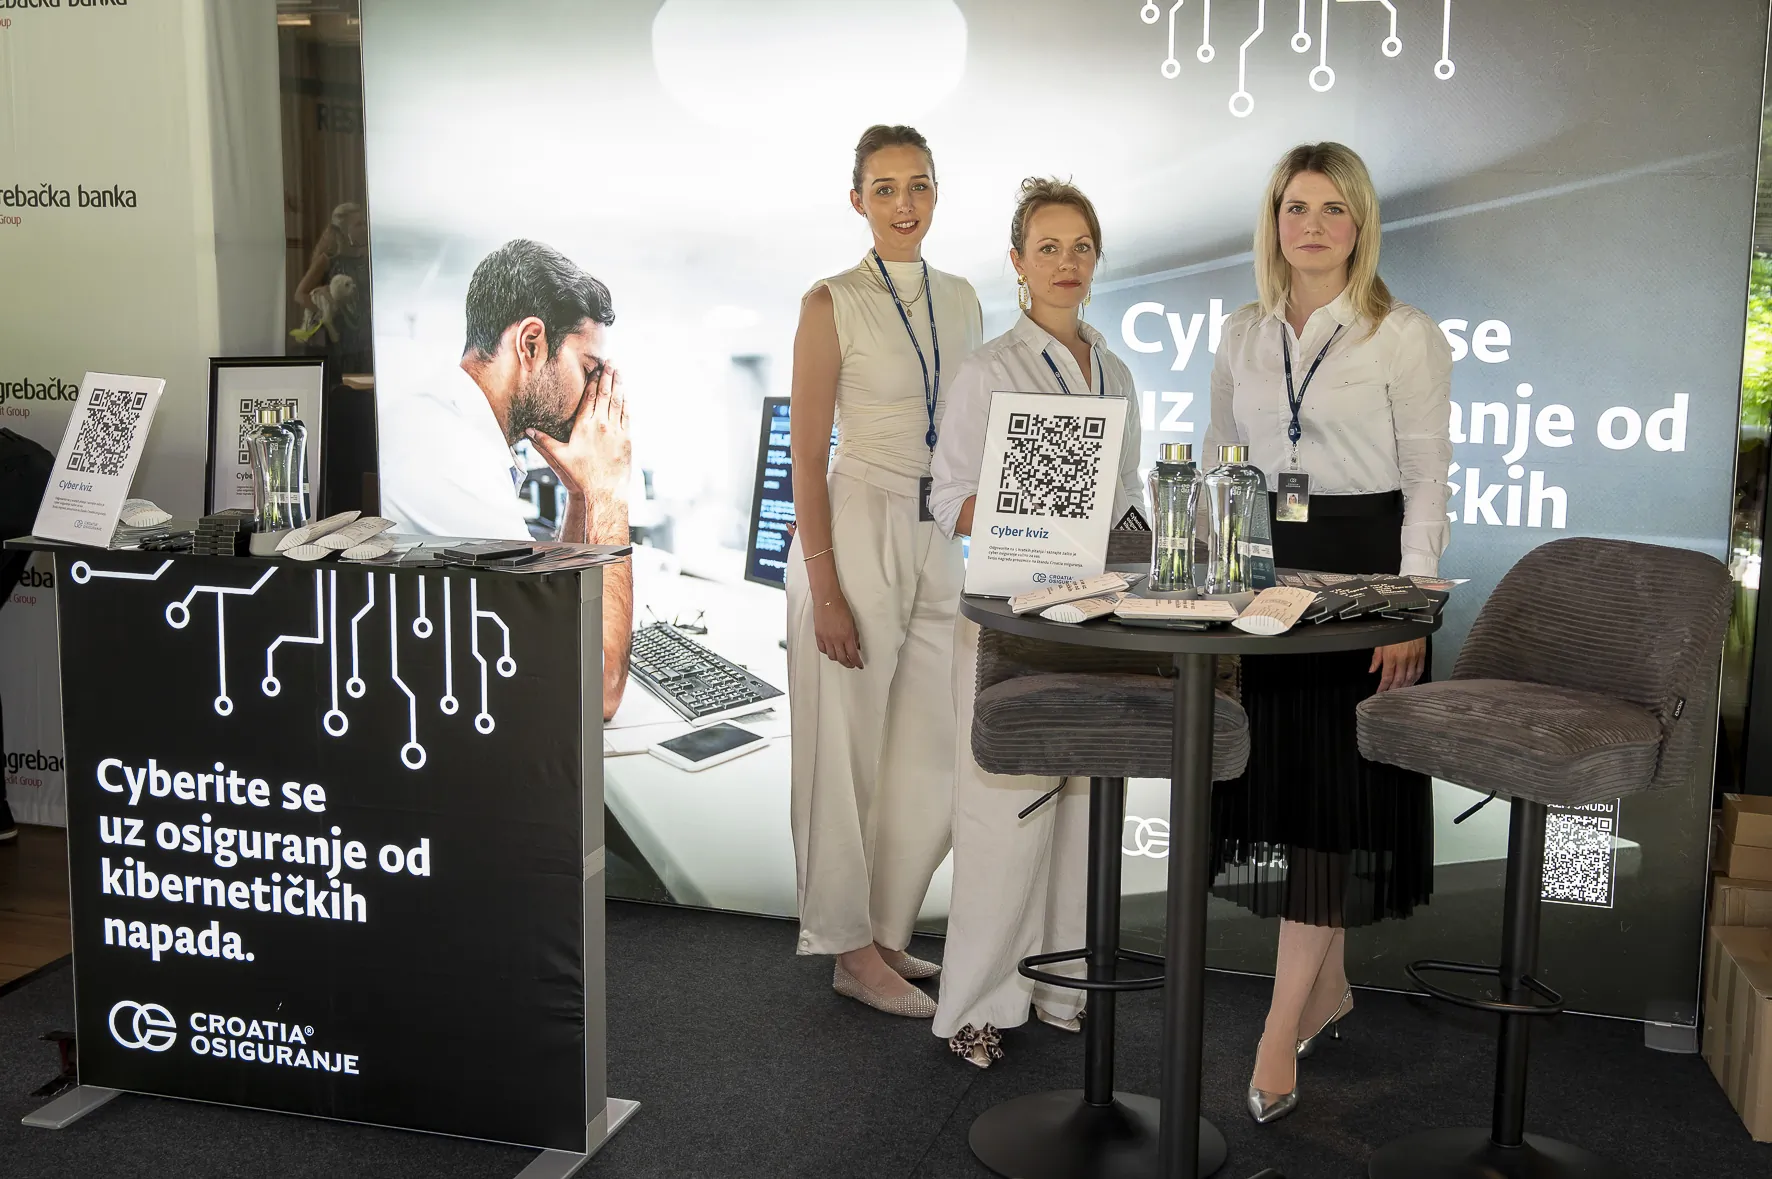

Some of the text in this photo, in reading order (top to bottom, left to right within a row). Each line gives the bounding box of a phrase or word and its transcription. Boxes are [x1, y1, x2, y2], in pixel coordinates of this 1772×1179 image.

[78, 184, 137, 208] banka
[1438, 318, 1512, 363] se
[7, 406, 30, 419] Group
[1597, 392, 1690, 452] od
[59, 479, 93, 492] Cyber kviz
[990, 525, 1049, 539] Cyber kviz
[97, 758, 327, 812] Cyberite se
[99, 812, 431, 879] uz osiguranje od
[101, 856, 367, 923] kibernetičkih
[104, 917, 255, 962] napada.
[190, 1035, 360, 1075] OSIGURANJE
